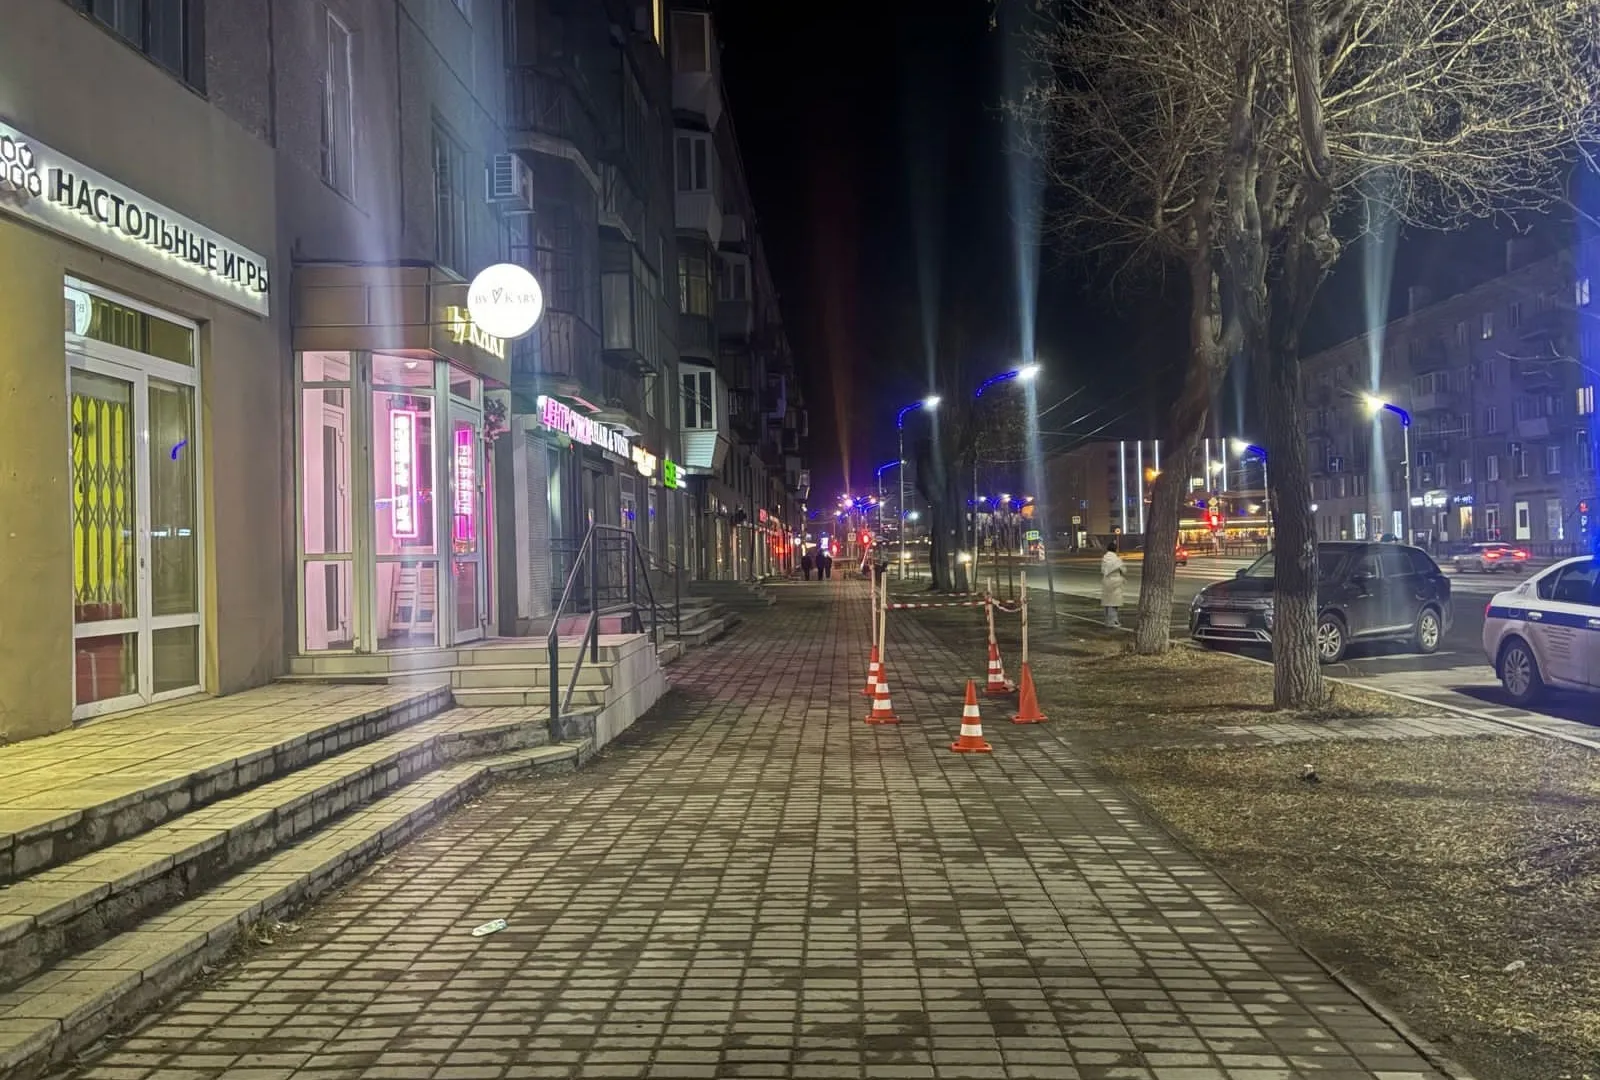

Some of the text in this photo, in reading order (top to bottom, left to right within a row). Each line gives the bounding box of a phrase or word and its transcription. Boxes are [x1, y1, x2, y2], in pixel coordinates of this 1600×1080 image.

[51, 168, 271, 294] НАСТОЛЬНЫЕ ИГРЫ
[543, 397, 570, 433] ЦЕНТР
